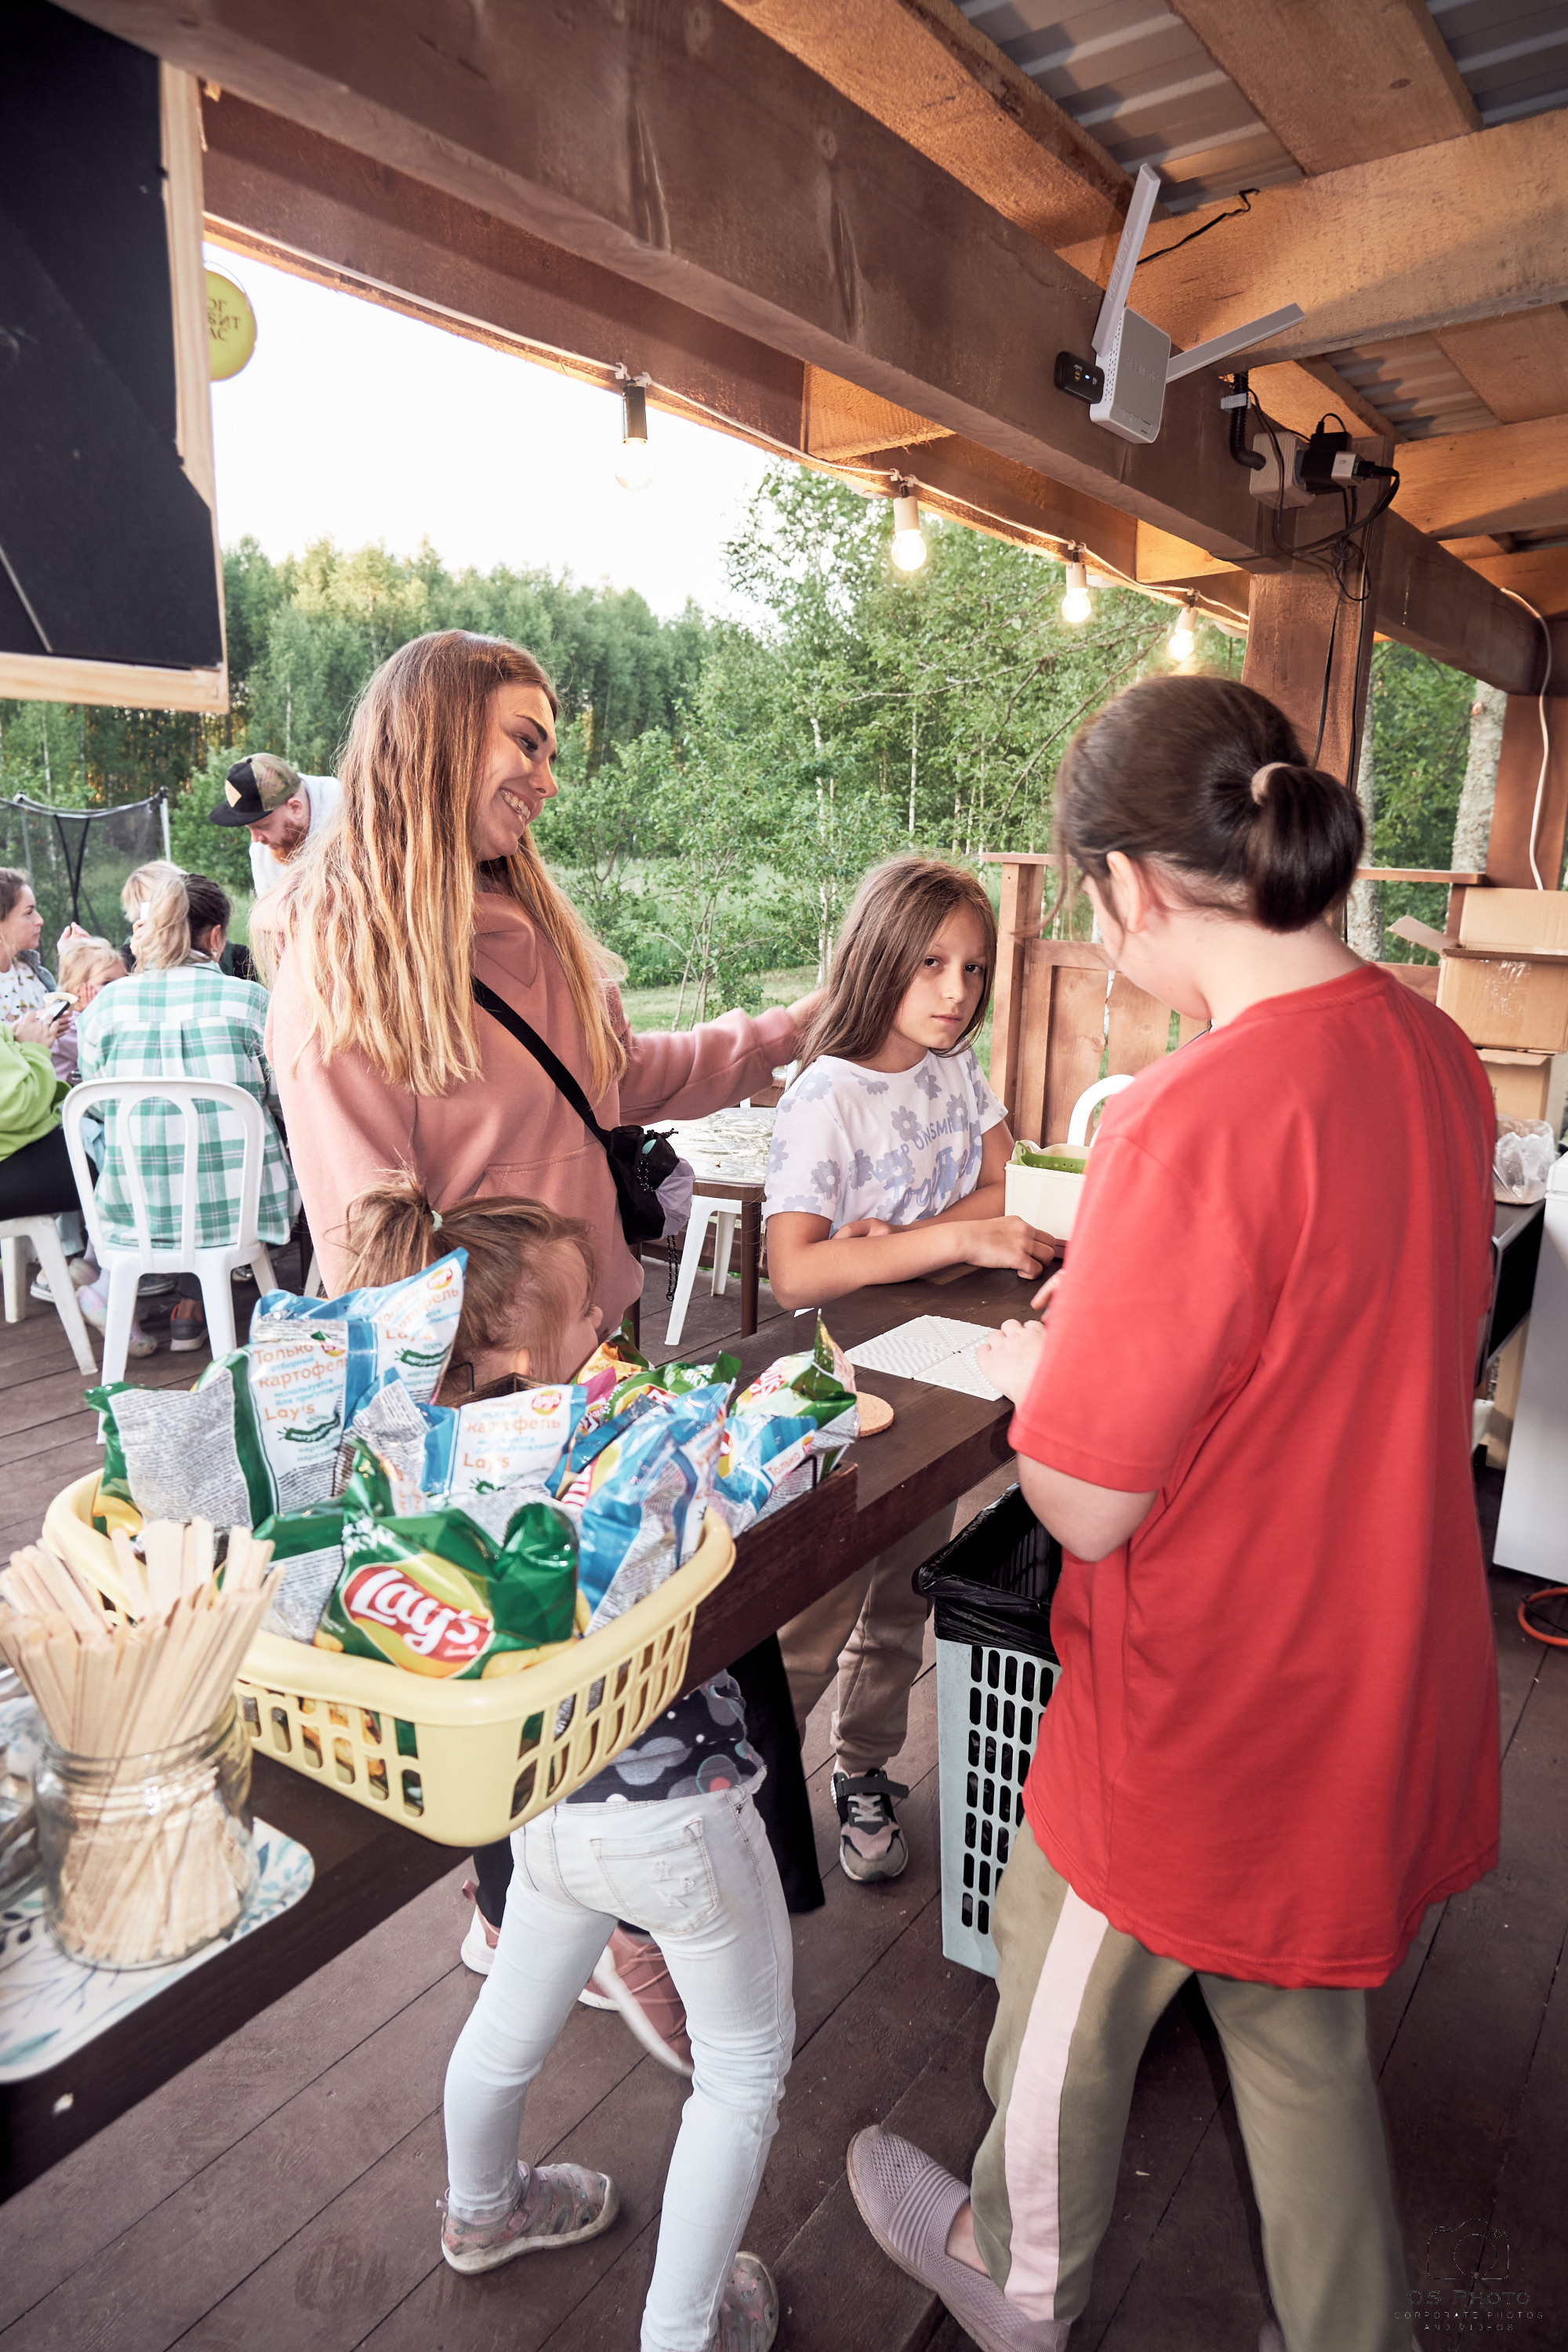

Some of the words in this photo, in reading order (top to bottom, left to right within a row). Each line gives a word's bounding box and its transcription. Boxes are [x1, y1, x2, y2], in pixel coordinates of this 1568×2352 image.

[207, 298, 227, 312] ОГ
[253, 1345, 314, 1365] Только
[264, 1403, 315, 1421] Lay's
[350, 1568, 481, 1656] Lay's
